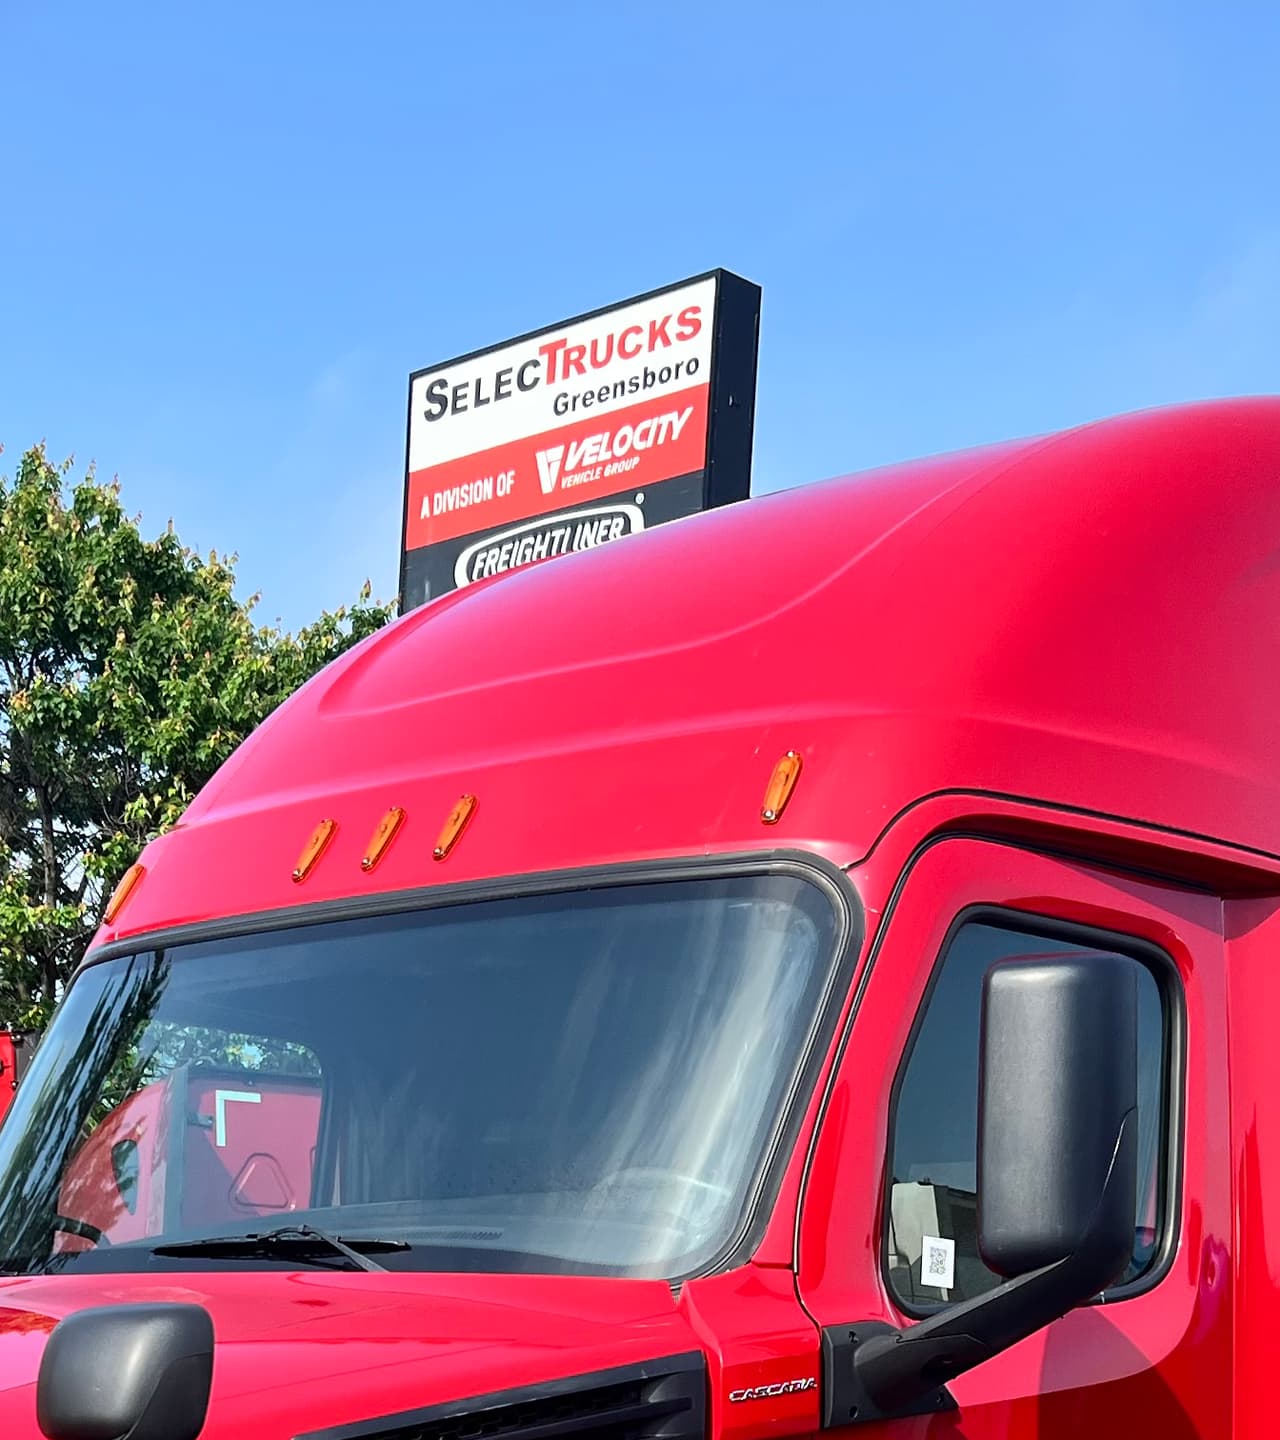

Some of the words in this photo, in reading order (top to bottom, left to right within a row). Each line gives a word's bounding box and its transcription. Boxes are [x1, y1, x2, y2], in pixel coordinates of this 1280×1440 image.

[553, 357, 699, 416] Greensboro
[564, 406, 694, 472] VELOCITY
[421, 495, 430, 520] A
[433, 476, 493, 516] DIVISION
[496, 469, 515, 497] OF
[561, 467, 602, 489] VEHICLE
[604, 456, 640, 477] GROUP
